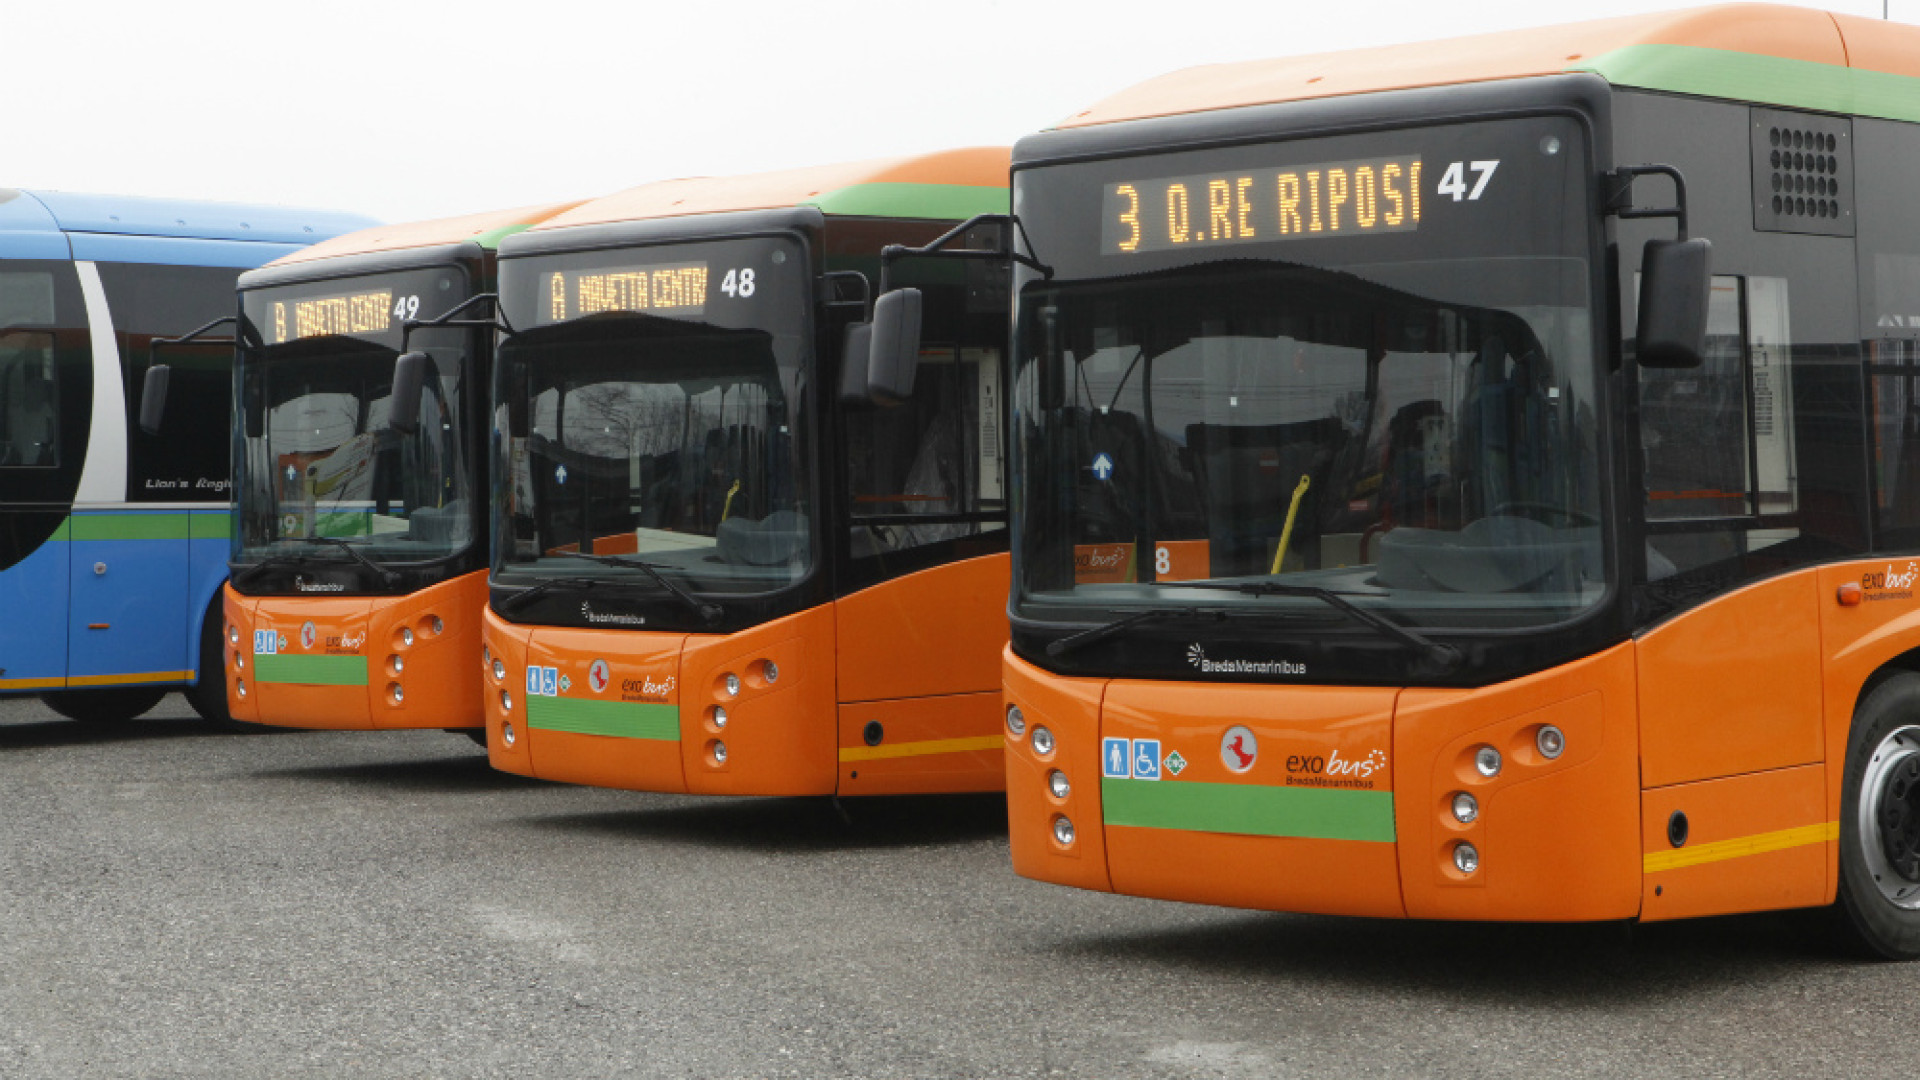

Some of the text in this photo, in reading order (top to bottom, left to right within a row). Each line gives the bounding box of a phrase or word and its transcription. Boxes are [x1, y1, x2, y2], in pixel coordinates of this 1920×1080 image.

[1437, 160, 1500, 202] 47
[1116, 184, 1140, 252] 3
[1166, 176, 1255, 243] Q.RE
[552, 271, 566, 321] A
[721, 267, 756, 299] 48
[393, 294, 420, 320] 49
[1286, 749, 1376, 778] exo bus
